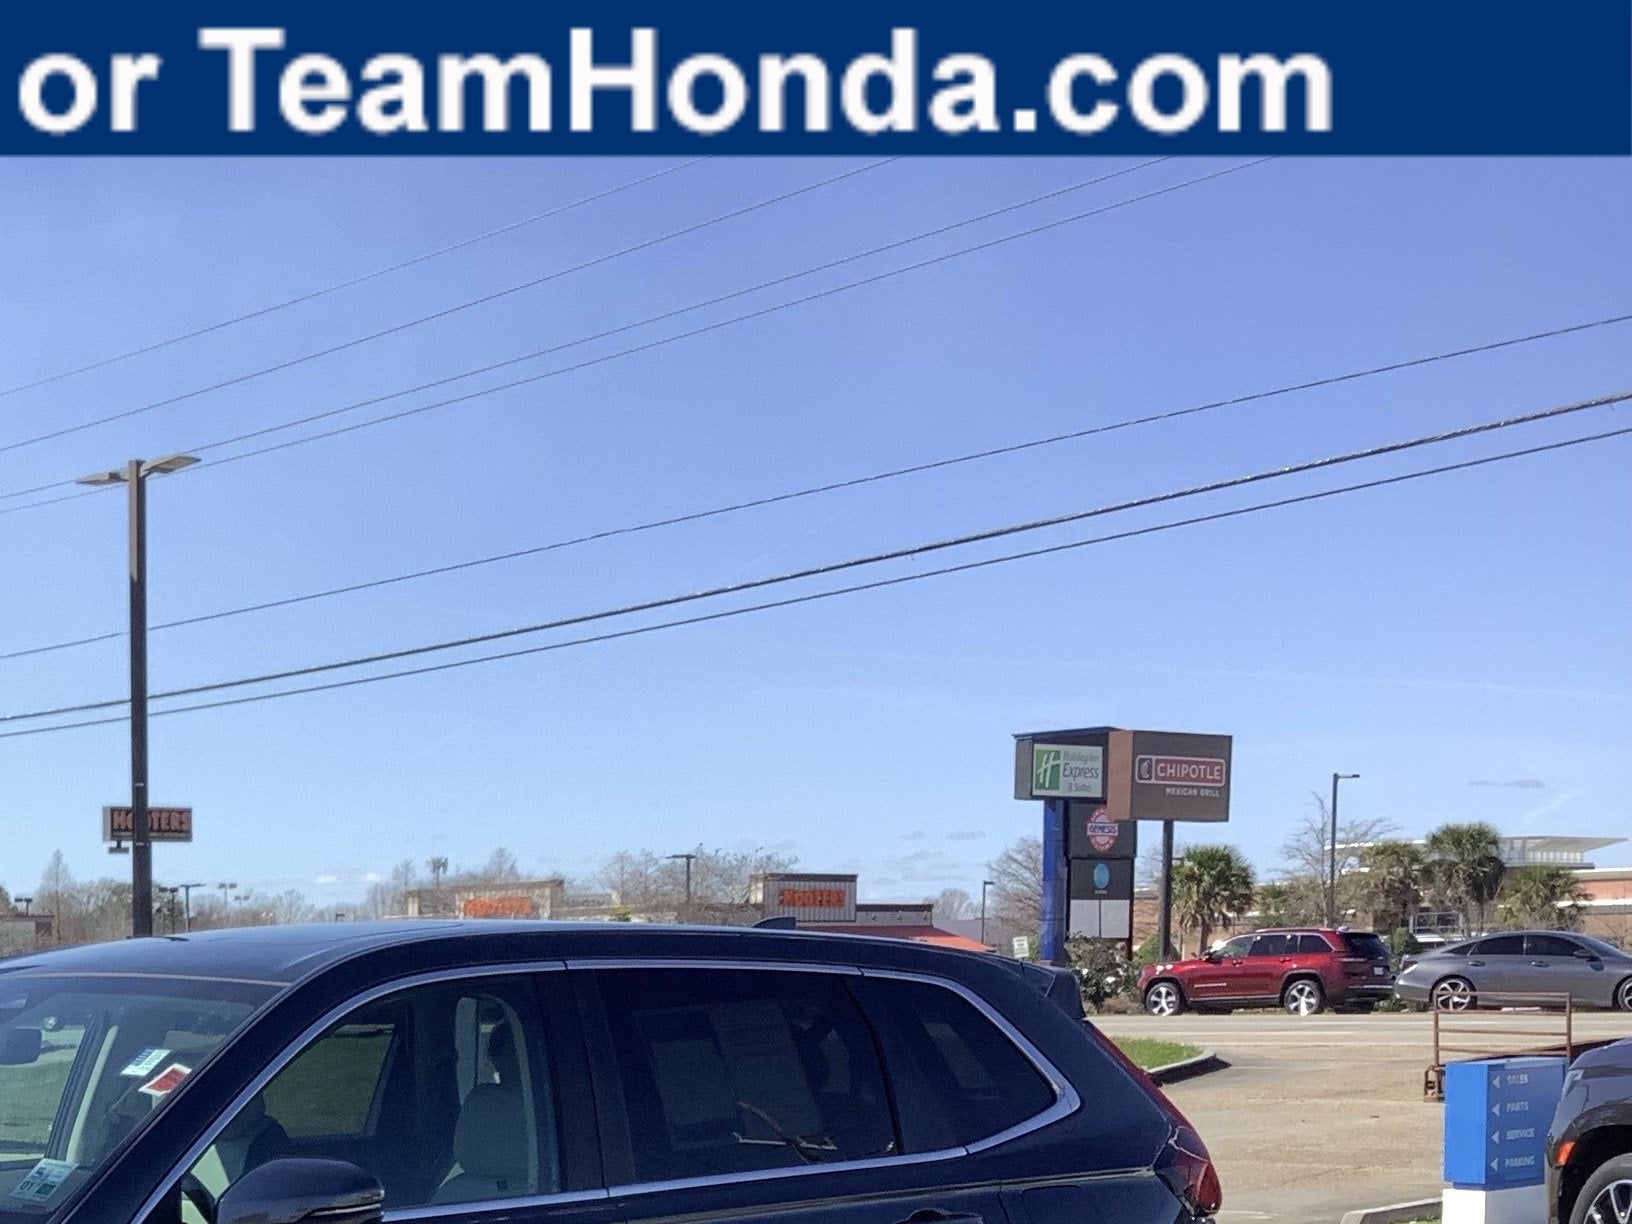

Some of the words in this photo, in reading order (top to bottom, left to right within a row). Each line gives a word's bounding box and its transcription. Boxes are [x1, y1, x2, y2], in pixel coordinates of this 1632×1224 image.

[1062, 762, 1100, 780] Express
[1157, 763, 1222, 780] CHIPOTLE
[1165, 787, 1199, 796] MEXICAN
[1200, 789, 1220, 797] GRILL
[1506, 1074, 1529, 1085] SALES
[1506, 1101, 1530, 1113] PARTS
[1506, 1128, 1536, 1141] SERVICE
[1505, 1156, 1536, 1168] PARKING
